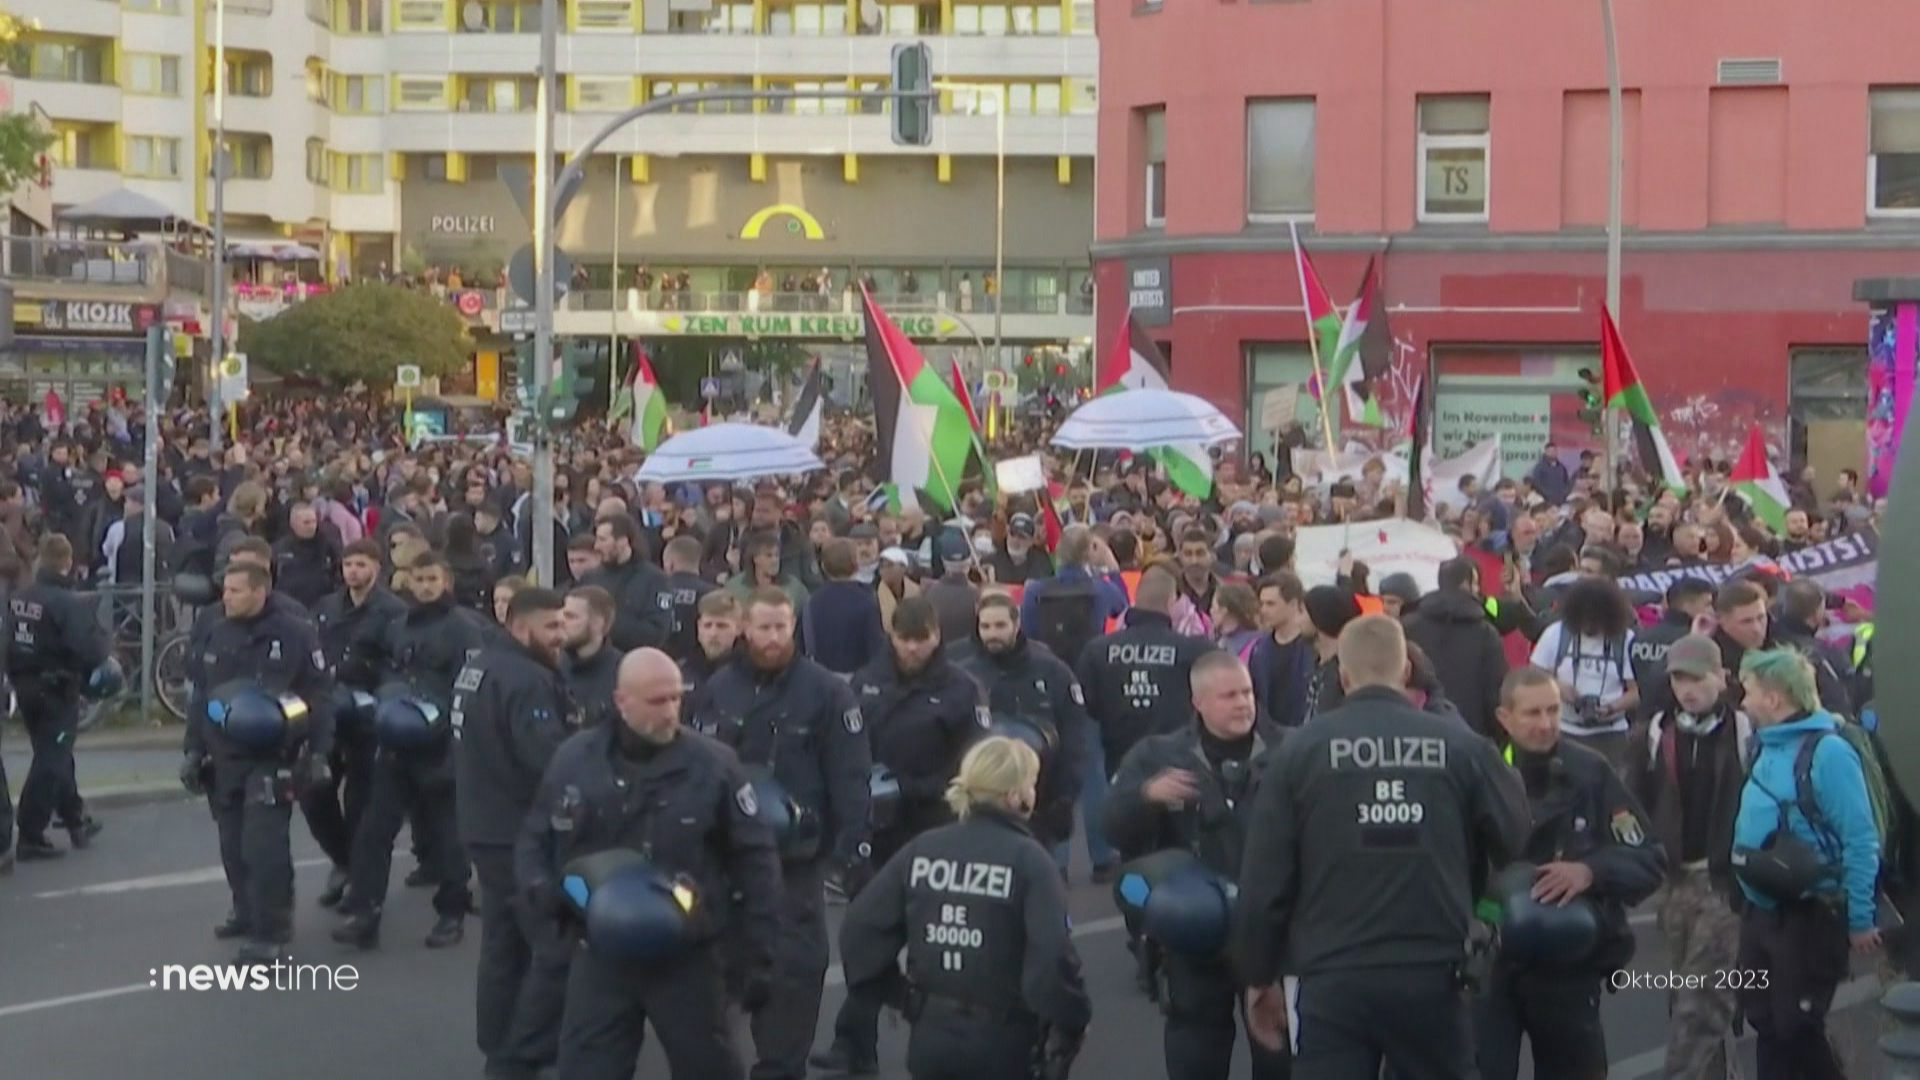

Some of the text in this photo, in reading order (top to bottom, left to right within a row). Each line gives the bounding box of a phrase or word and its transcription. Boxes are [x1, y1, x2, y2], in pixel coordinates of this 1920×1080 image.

[432, 215, 495, 233] POLIZEI
[66, 302, 133, 323] KIOSK
[684, 314, 792, 334] ZENRUM
[1442, 410, 1460, 423] Im
[1463, 411, 1537, 424] November
[1442, 428, 1463, 441] wir
[1108, 644, 1177, 666] POLIZEI
[1632, 642, 1673, 661] POLIZ
[1330, 736, 1446, 769] POLIZEI
[1376, 780, 1405, 800] BE
[1357, 803, 1423, 823] 30009
[910, 856, 1013, 899] POLIZEI
[941, 903, 967, 925] BE
[925, 923, 983, 948] 30000
